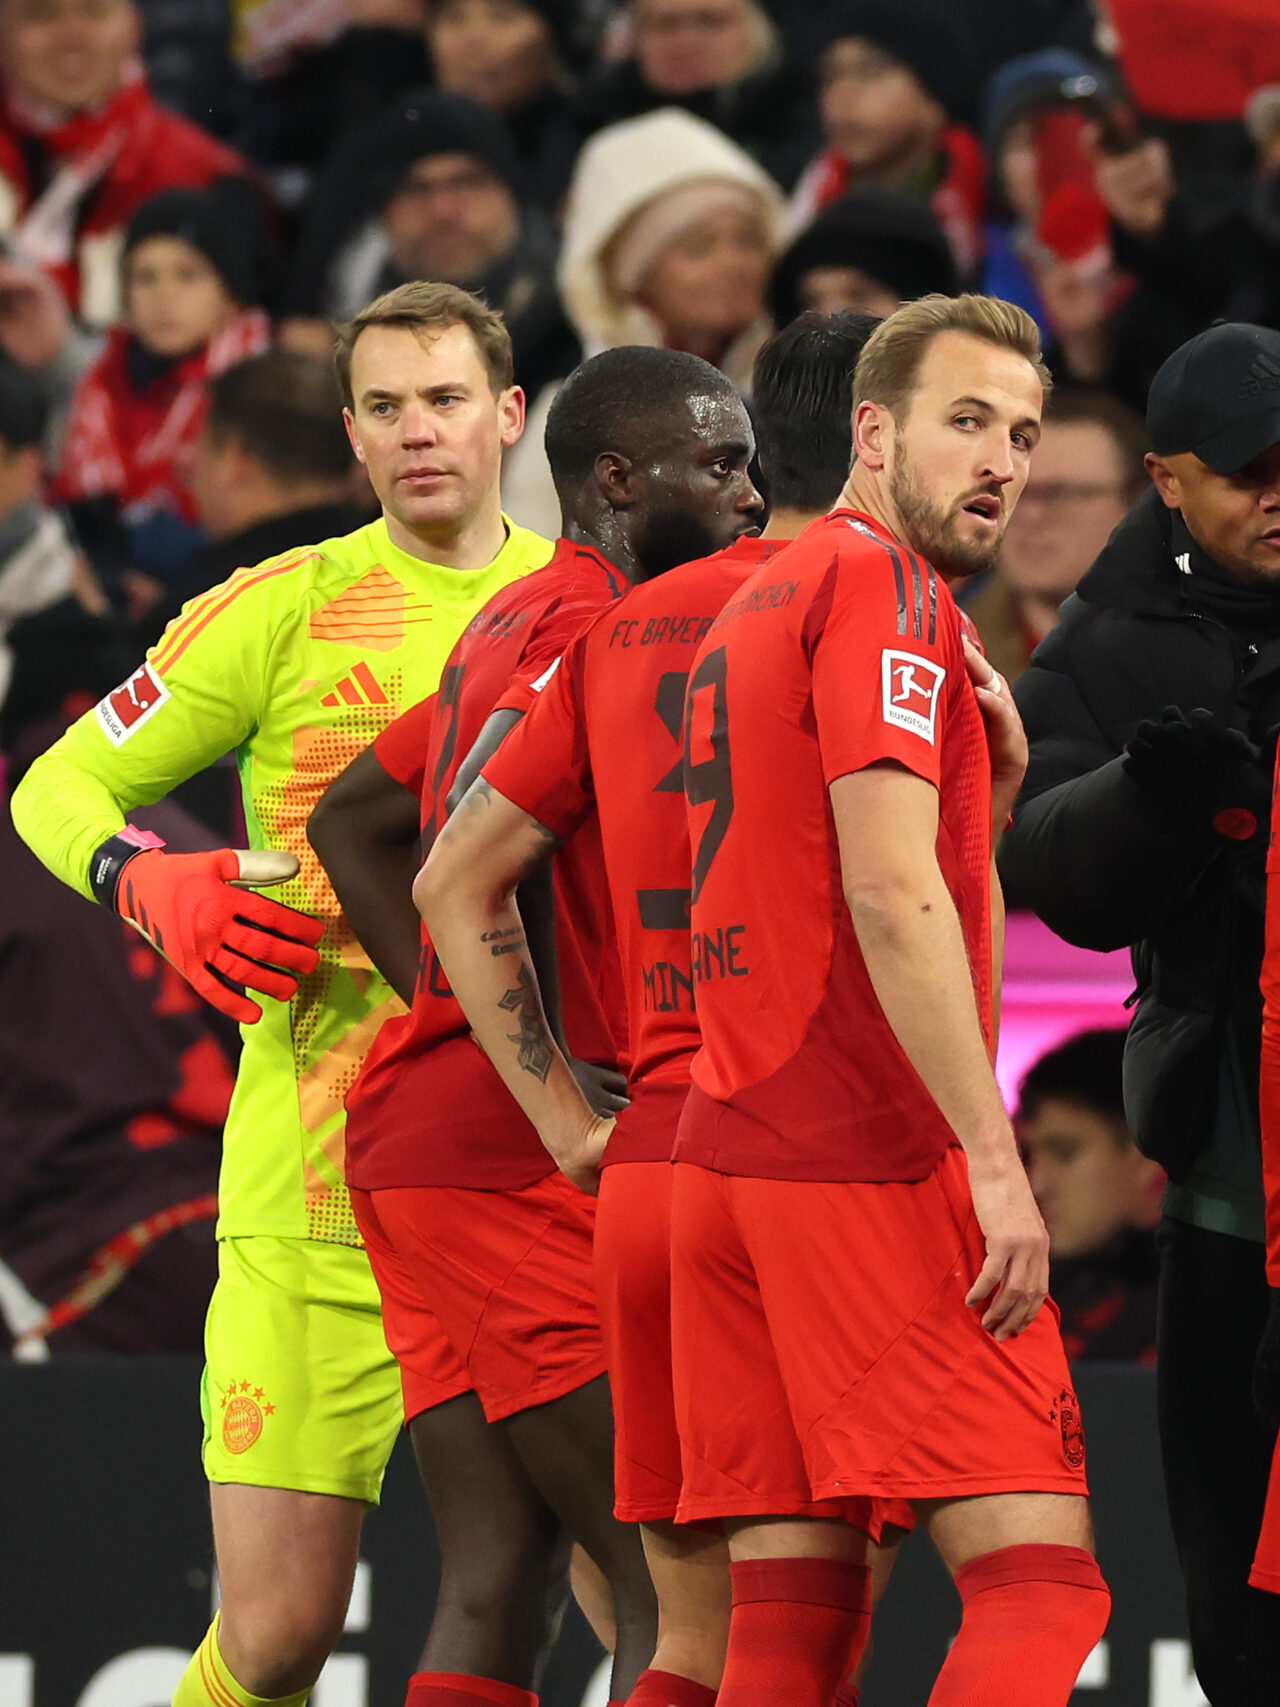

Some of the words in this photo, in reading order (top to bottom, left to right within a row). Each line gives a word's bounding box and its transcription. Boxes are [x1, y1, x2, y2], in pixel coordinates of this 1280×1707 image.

[609, 620, 639, 648] FC
[640, 616, 716, 646] BAYER
[684, 645, 734, 908] 9
[692, 925, 749, 983] ANE
[642, 961, 696, 1013] MIN
